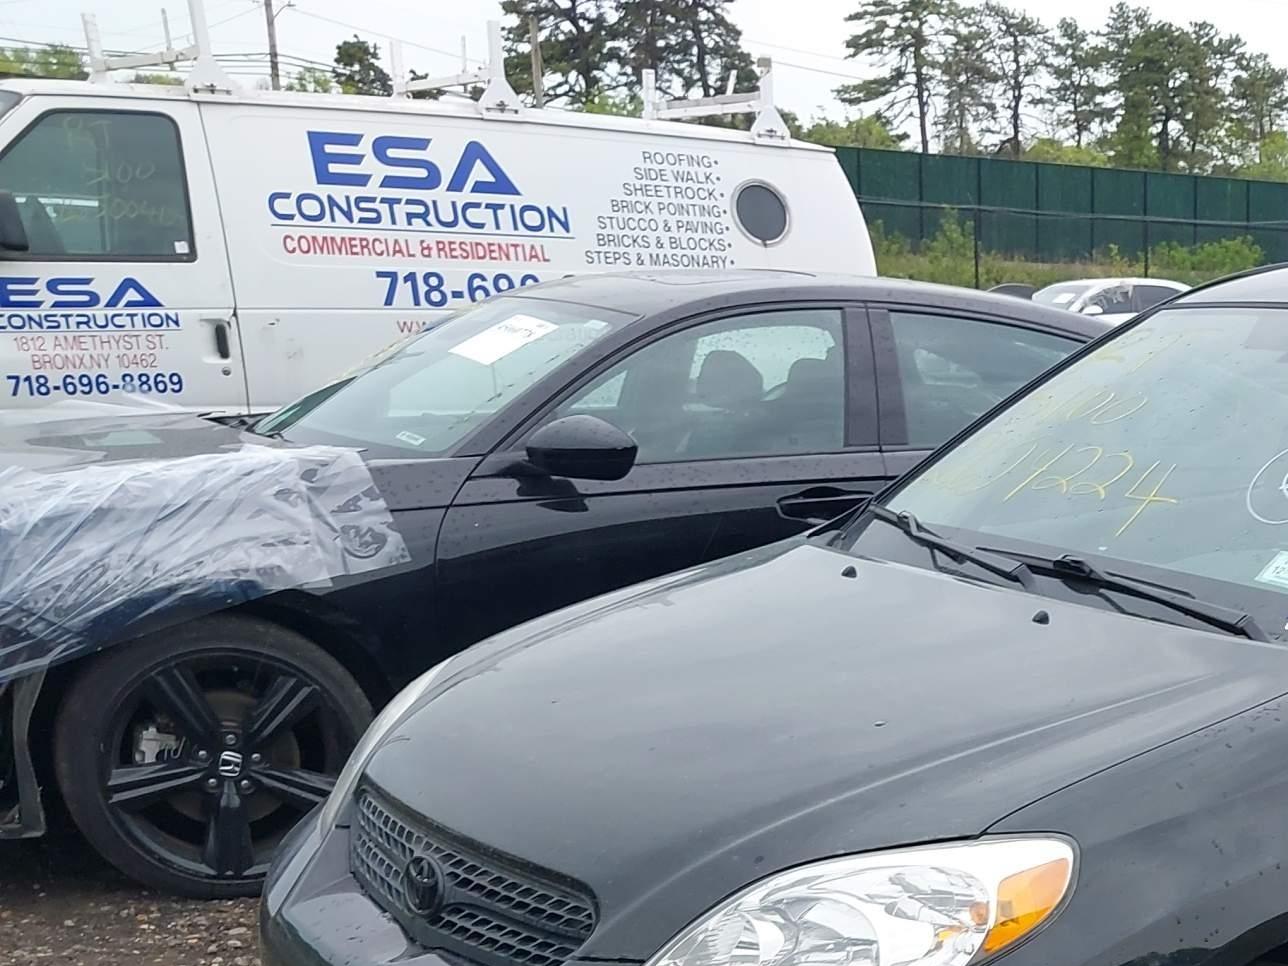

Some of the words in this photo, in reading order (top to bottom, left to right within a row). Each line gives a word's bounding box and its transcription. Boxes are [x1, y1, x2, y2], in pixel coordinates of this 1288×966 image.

[307, 130, 522, 195] ESA
[642, 151, 712, 168] ROOFING
[633, 167, 669, 182] SIDE
[672, 169, 715, 185] WALK
[622, 183, 718, 201] SHEETROCK
[268, 192, 570, 233] CONSTRUCTION
[610, 199, 654, 216] BRICK
[658, 202, 721, 218] POINTING
[597, 216, 658, 232] STUCCO
[663, 220, 671, 233] &
[676, 220, 724, 235] PAVING
[282, 234, 416, 257] COMMERCIAL
[420, 239, 433, 258] &
[434, 240, 550, 262] RESIDENTIAL
[596, 233, 650, 249] BRICKS
[655, 236, 664, 249] &
[669, 236, 726, 252] BLOCKS
[585, 250, 632, 266] STEPS
[636, 252, 645, 266] &
[649, 253, 728, 269] MASONARY
[0, 277, 166, 308] ESA
[13, 336, 47, 352] 1812
[53, 334, 142, 351] AMETHYST
[116, 353, 158, 369] 10462
[6, 372, 184, 397] 718-696-8869
